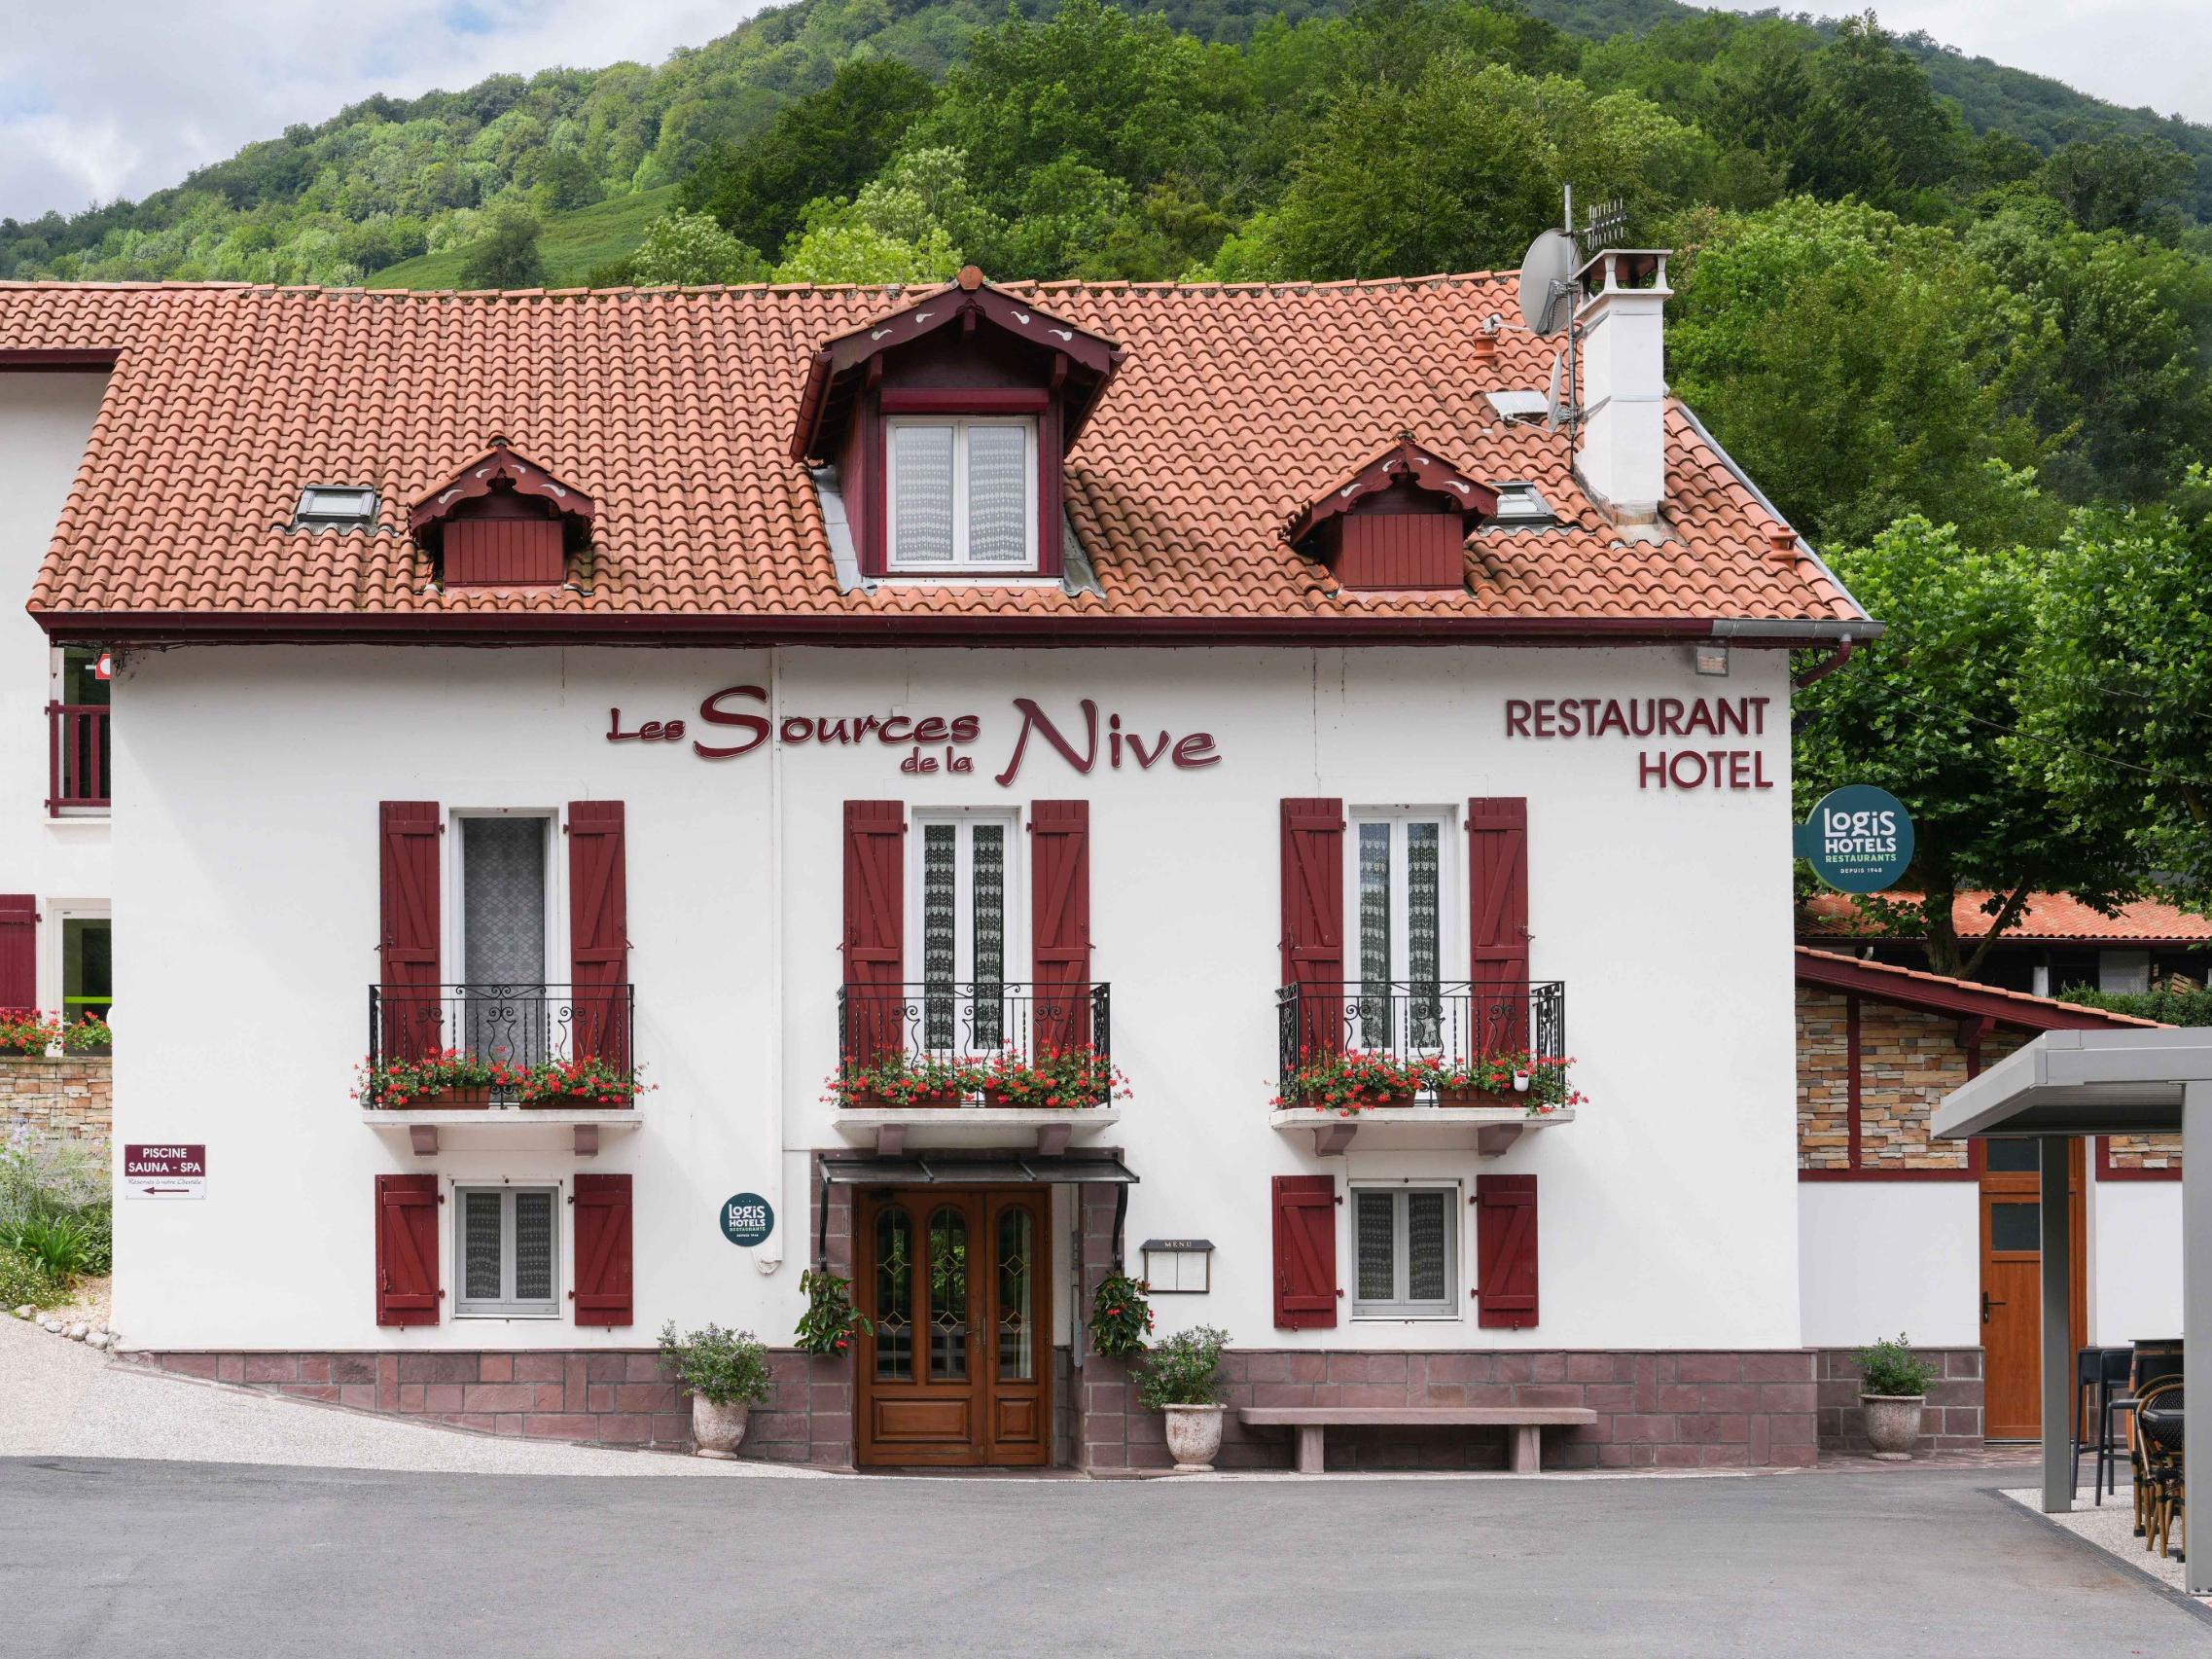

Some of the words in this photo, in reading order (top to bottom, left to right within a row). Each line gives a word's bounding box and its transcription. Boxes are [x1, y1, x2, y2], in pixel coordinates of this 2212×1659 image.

[606, 707, 687, 741] Les
[693, 685, 981, 759] Sources
[1506, 697, 1769, 738] RESTAURANT
[995, 698, 1222, 786] Nive
[901, 746, 941, 773] de
[946, 746, 974, 773] la
[1639, 750, 1773, 789] HOTEL
[1825, 837, 1897, 853] HOTELS
[1825, 853, 1897, 863] RESTAURANTS
[143, 1148, 187, 1158] PISCINE
[128, 1162, 169, 1172] SAUNA
[180, 1162, 201, 1172] SPA
[729, 1218, 766, 1227] HOTELS
